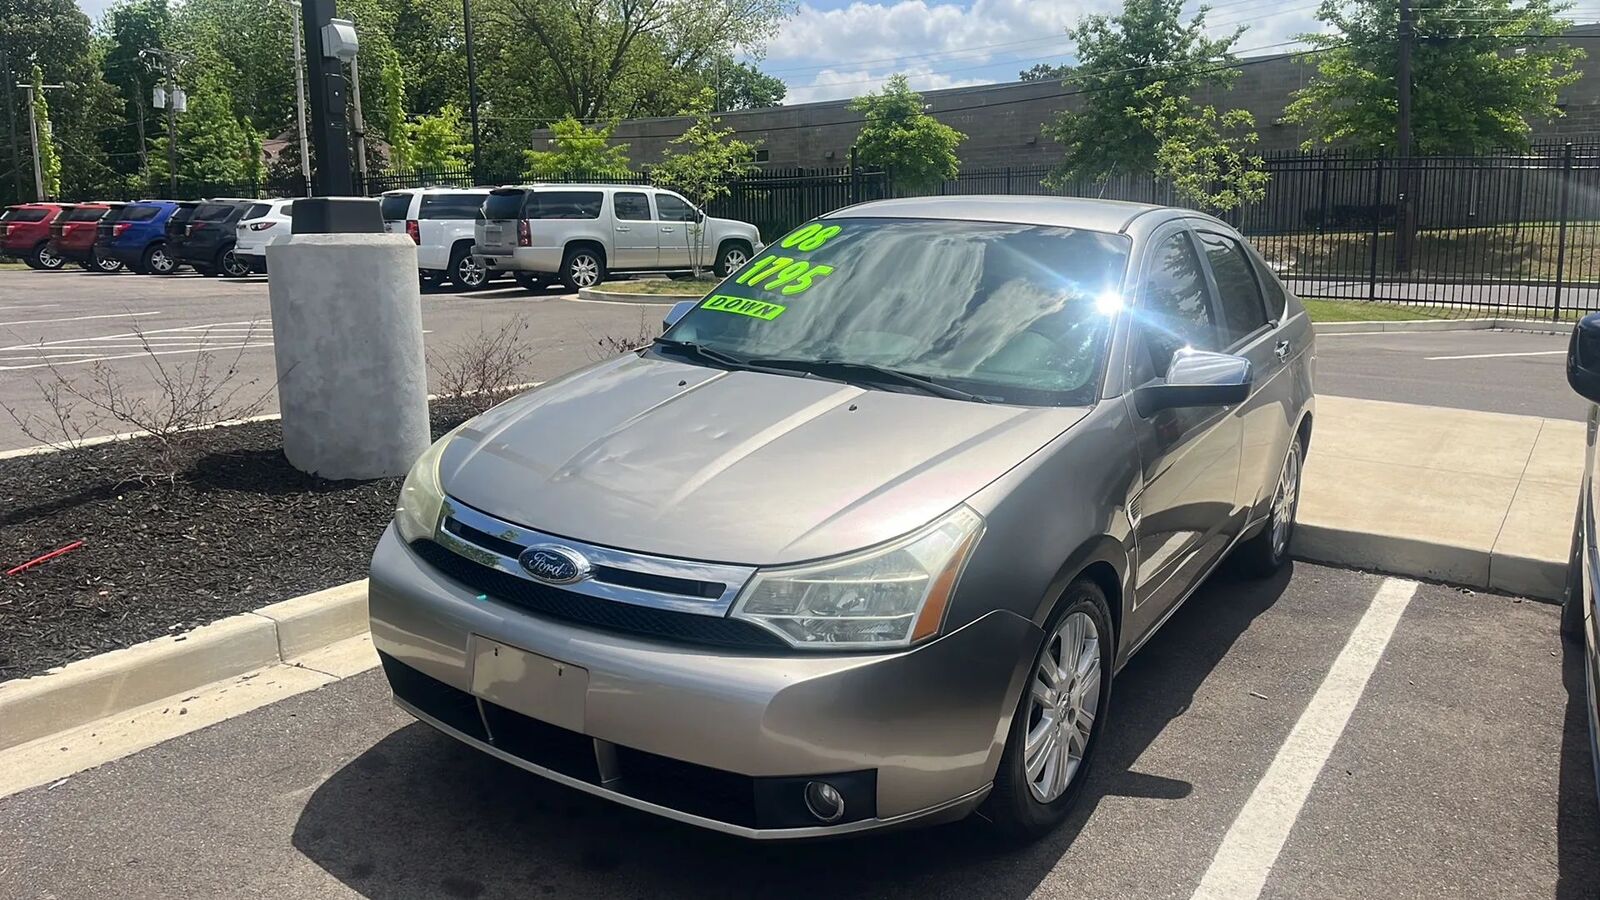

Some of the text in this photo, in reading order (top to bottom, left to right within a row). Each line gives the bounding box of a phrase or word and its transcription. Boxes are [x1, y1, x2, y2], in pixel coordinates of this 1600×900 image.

[781, 223, 842, 251] 08
[736, 255, 834, 295] 1795
[708, 297, 778, 316] DOWN
[528, 552, 565, 577] Ford
